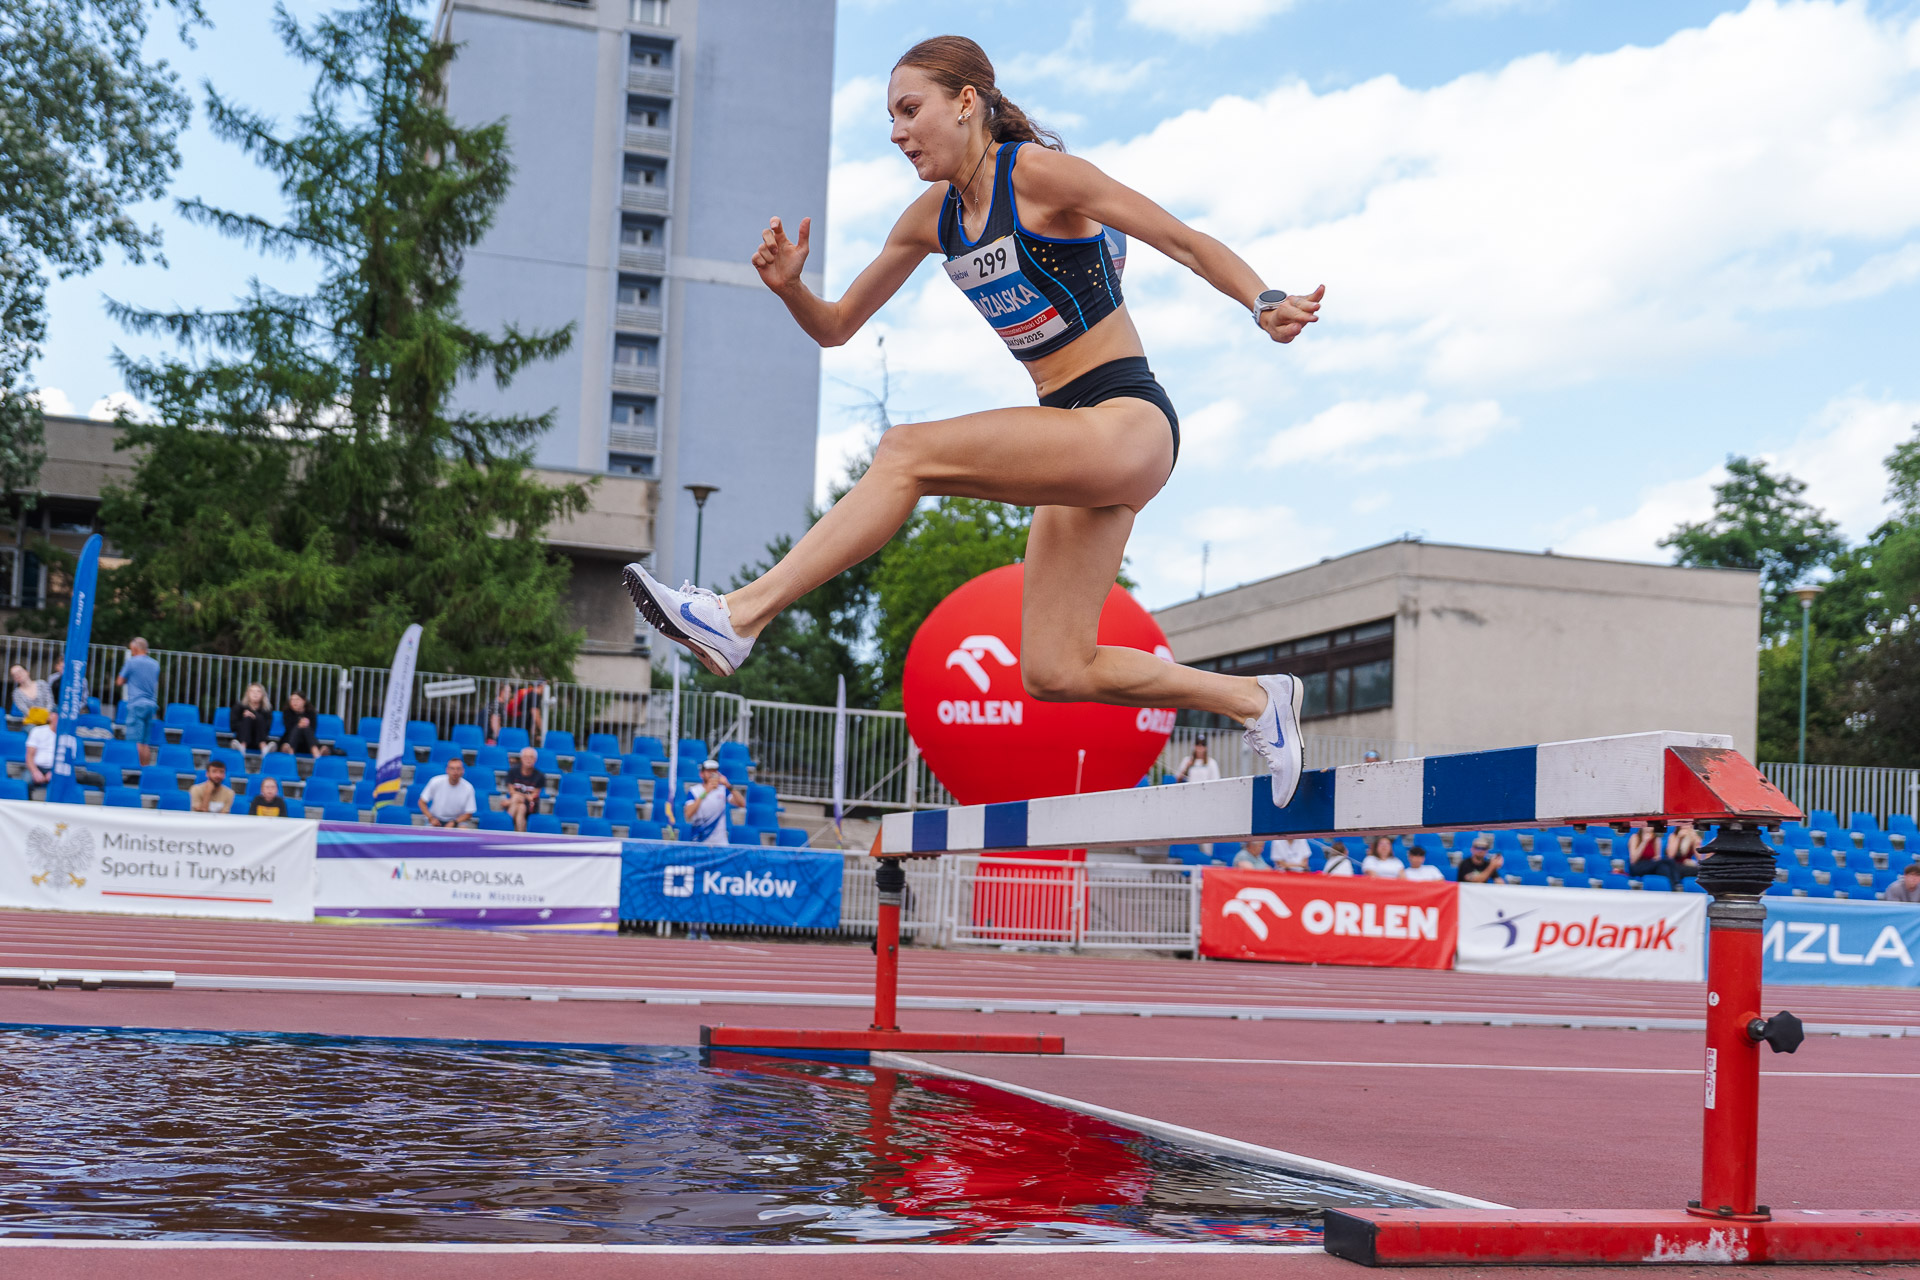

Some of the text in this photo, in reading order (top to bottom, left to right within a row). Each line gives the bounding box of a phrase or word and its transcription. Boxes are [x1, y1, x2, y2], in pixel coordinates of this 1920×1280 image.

[973, 247, 1007, 278] 299
[1024, 330, 1045, 344] 2025
[937, 700, 1024, 725] ORLEN
[1136, 707, 1177, 735] ORLE
[103, 832, 235, 857] Ministerstwo
[101, 856, 276, 885] Sportu i Turystyki
[415, 868, 525, 886] MAŁOPOLSKA
[703, 870, 798, 898] Kraków
[1301, 899, 1439, 940] ORLEN
[1532, 914, 1678, 953] polanik
